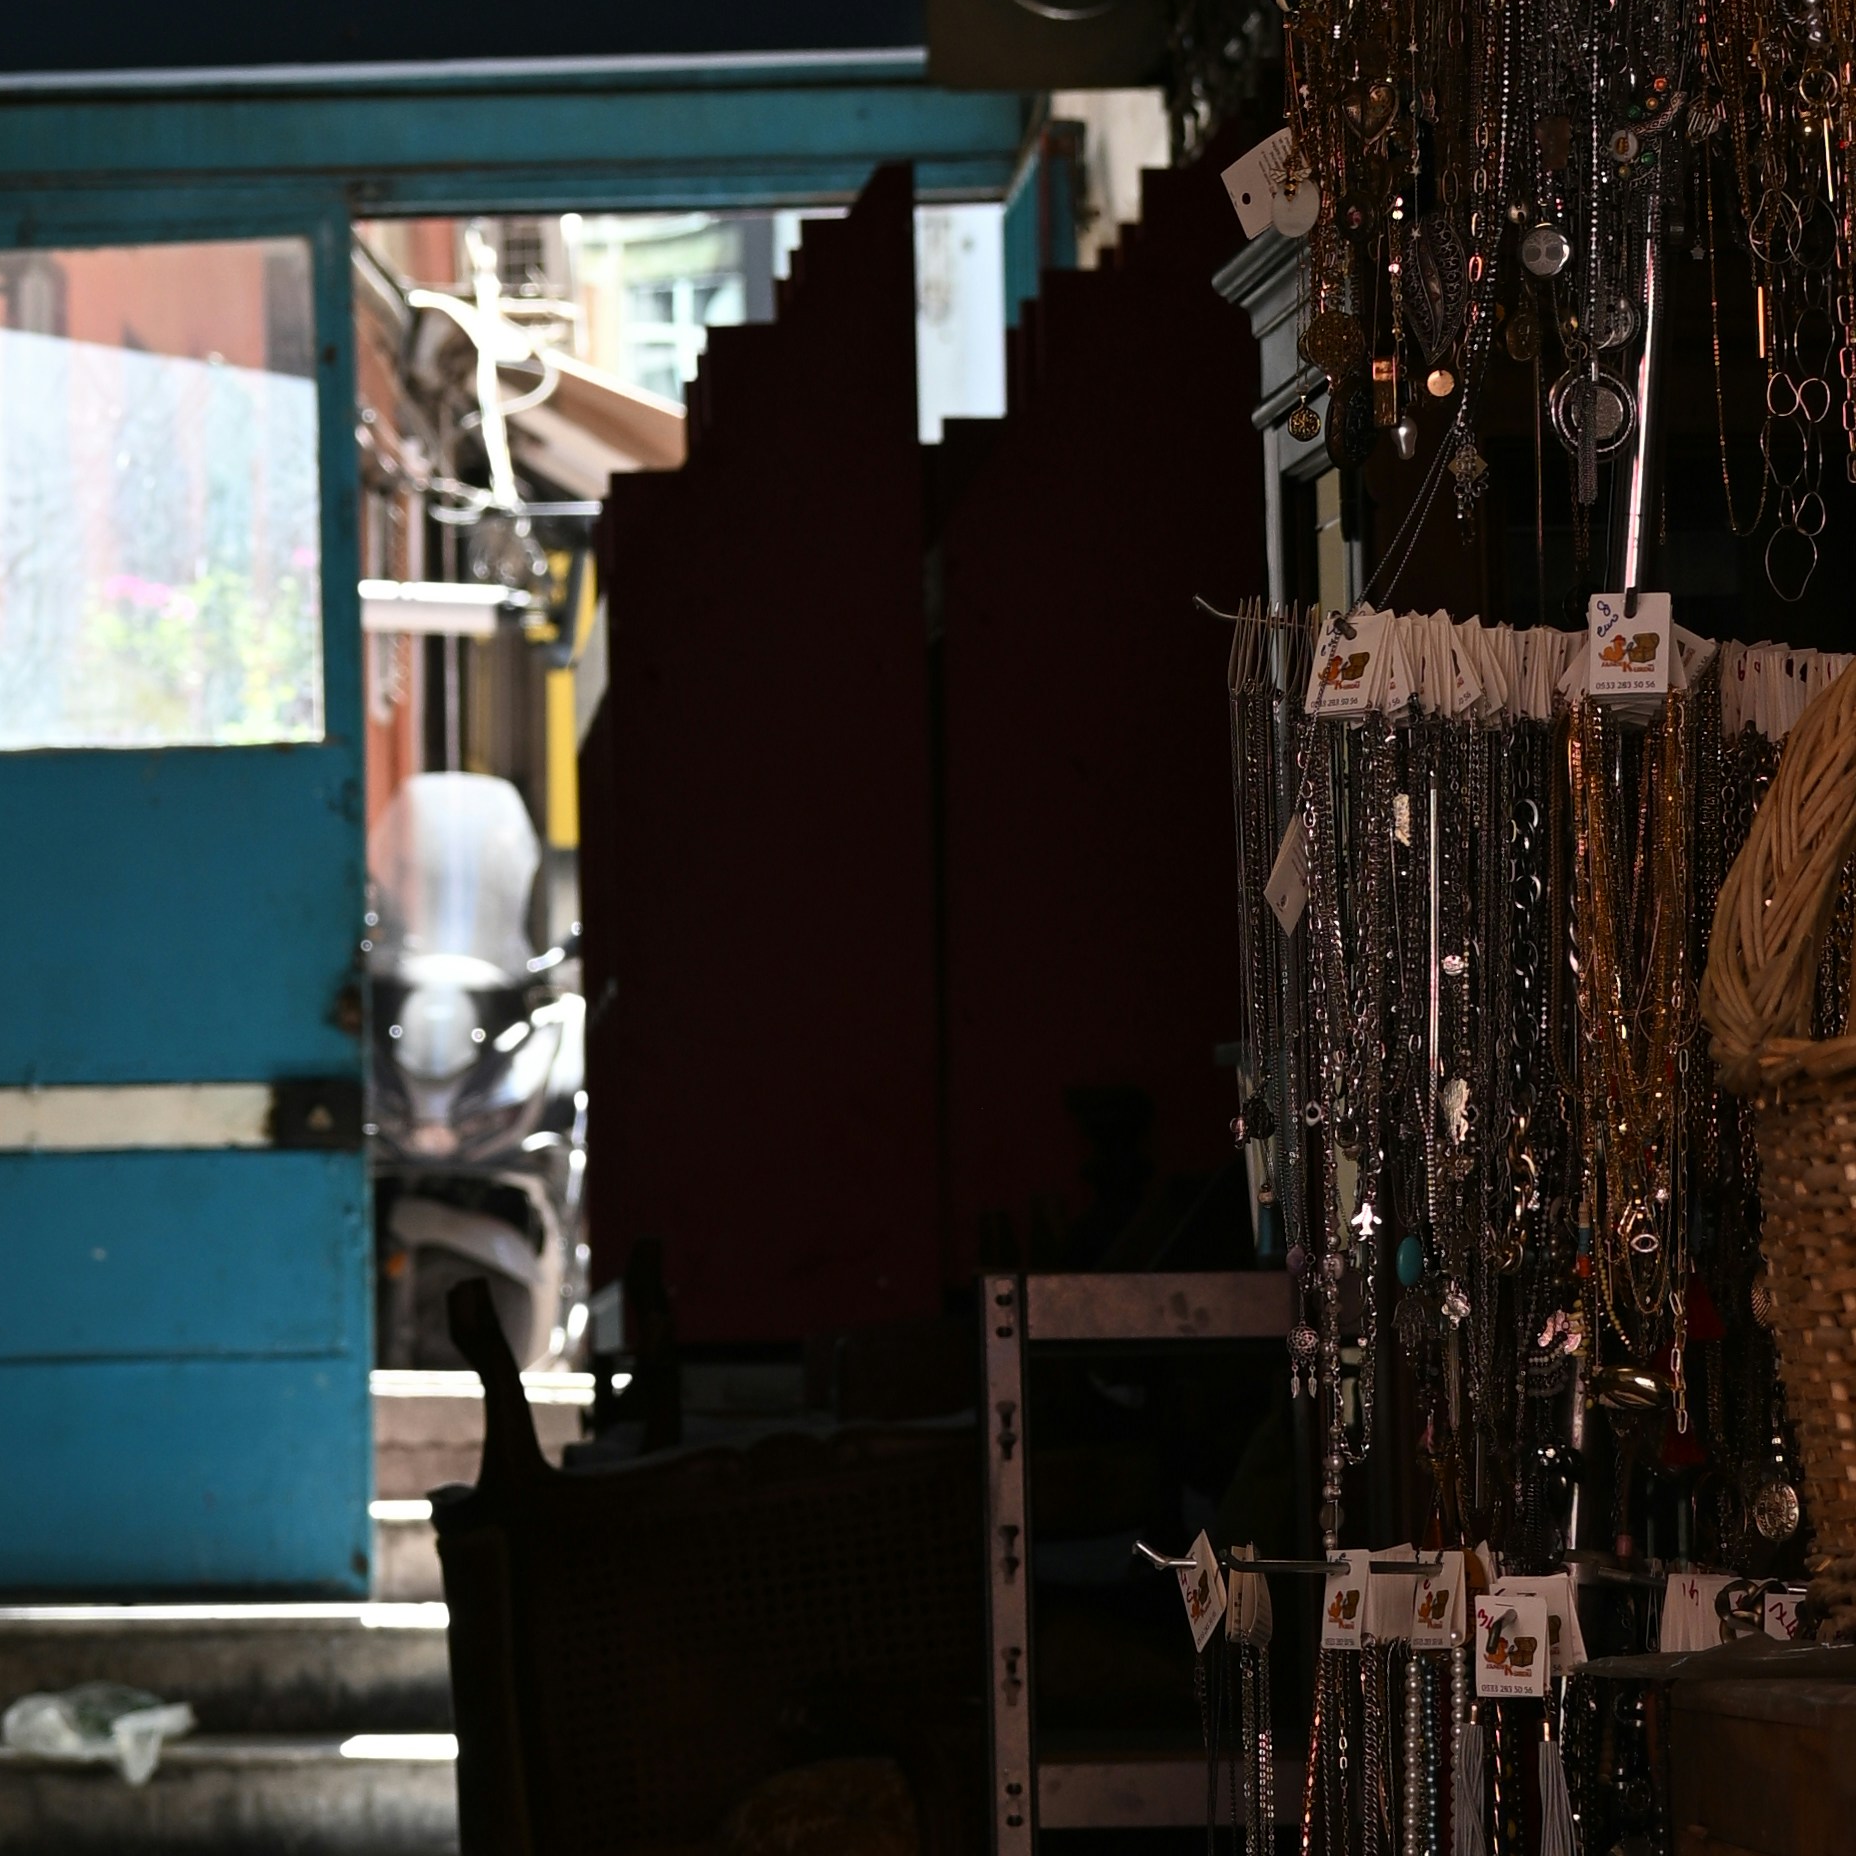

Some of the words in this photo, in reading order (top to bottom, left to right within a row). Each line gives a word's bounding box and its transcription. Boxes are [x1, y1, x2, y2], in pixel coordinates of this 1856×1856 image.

[1596, 600, 1611, 616] 8
[1597, 614, 1618, 637] euro
[1596, 681, 1615, 689] 0533
[1617, 681, 1631, 689] 283
[1481, 1684, 1498, 1692] 0533
[1500, 1685, 1512, 1693] 283
[1514, 1685, 1522, 1693] 50
[1524, 1685, 1533, 1694] 56
